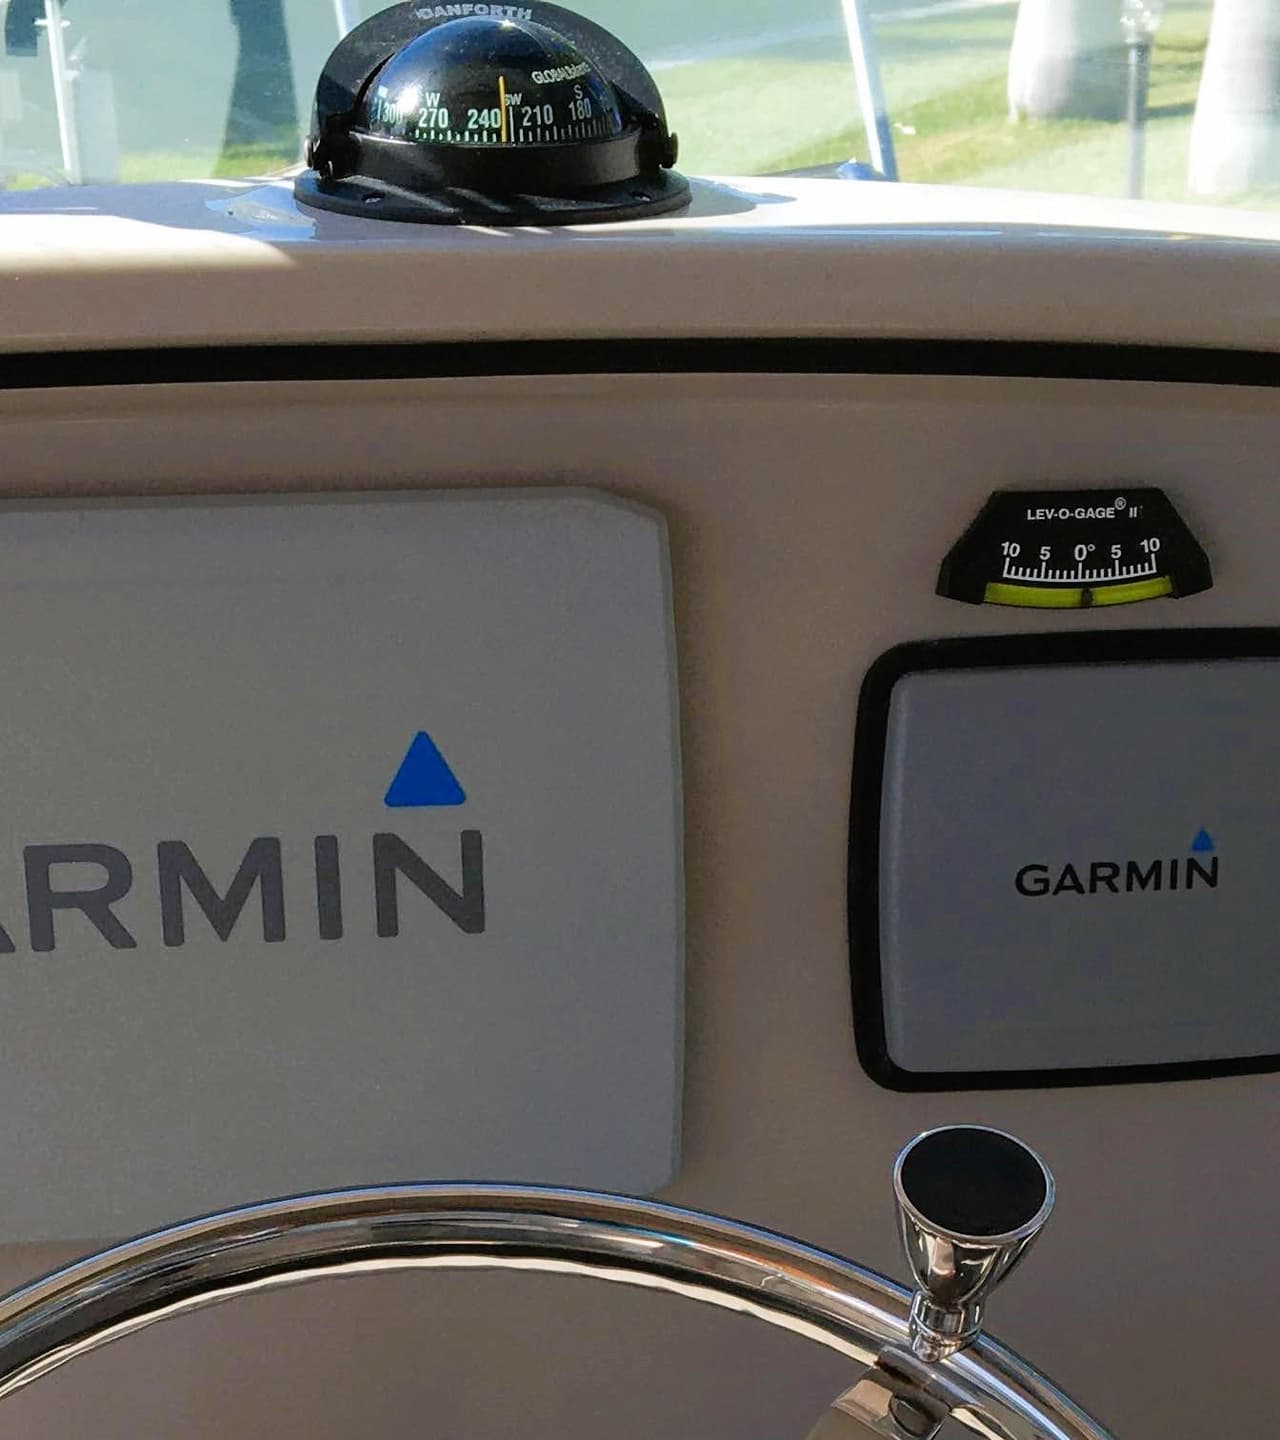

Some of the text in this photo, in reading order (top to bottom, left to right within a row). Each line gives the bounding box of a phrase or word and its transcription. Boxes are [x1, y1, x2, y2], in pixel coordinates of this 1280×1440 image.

[416, 3, 533, 20] DANFORTH
[425, 91, 441, 107] W
[573, 84, 584, 99] S
[418, 108, 449, 129] 270
[467, 108, 501, 129] 240
[521, 104, 554, 126] 210
[568, 98, 592, 121] 180
[1001, 541, 1021, 558] 10
[1040, 546, 1051, 561] 5
[1111, 544, 1122, 559] 5
[1140, 537, 1161, 554] 10
[1014, 855, 1219, 897] GARMIN
